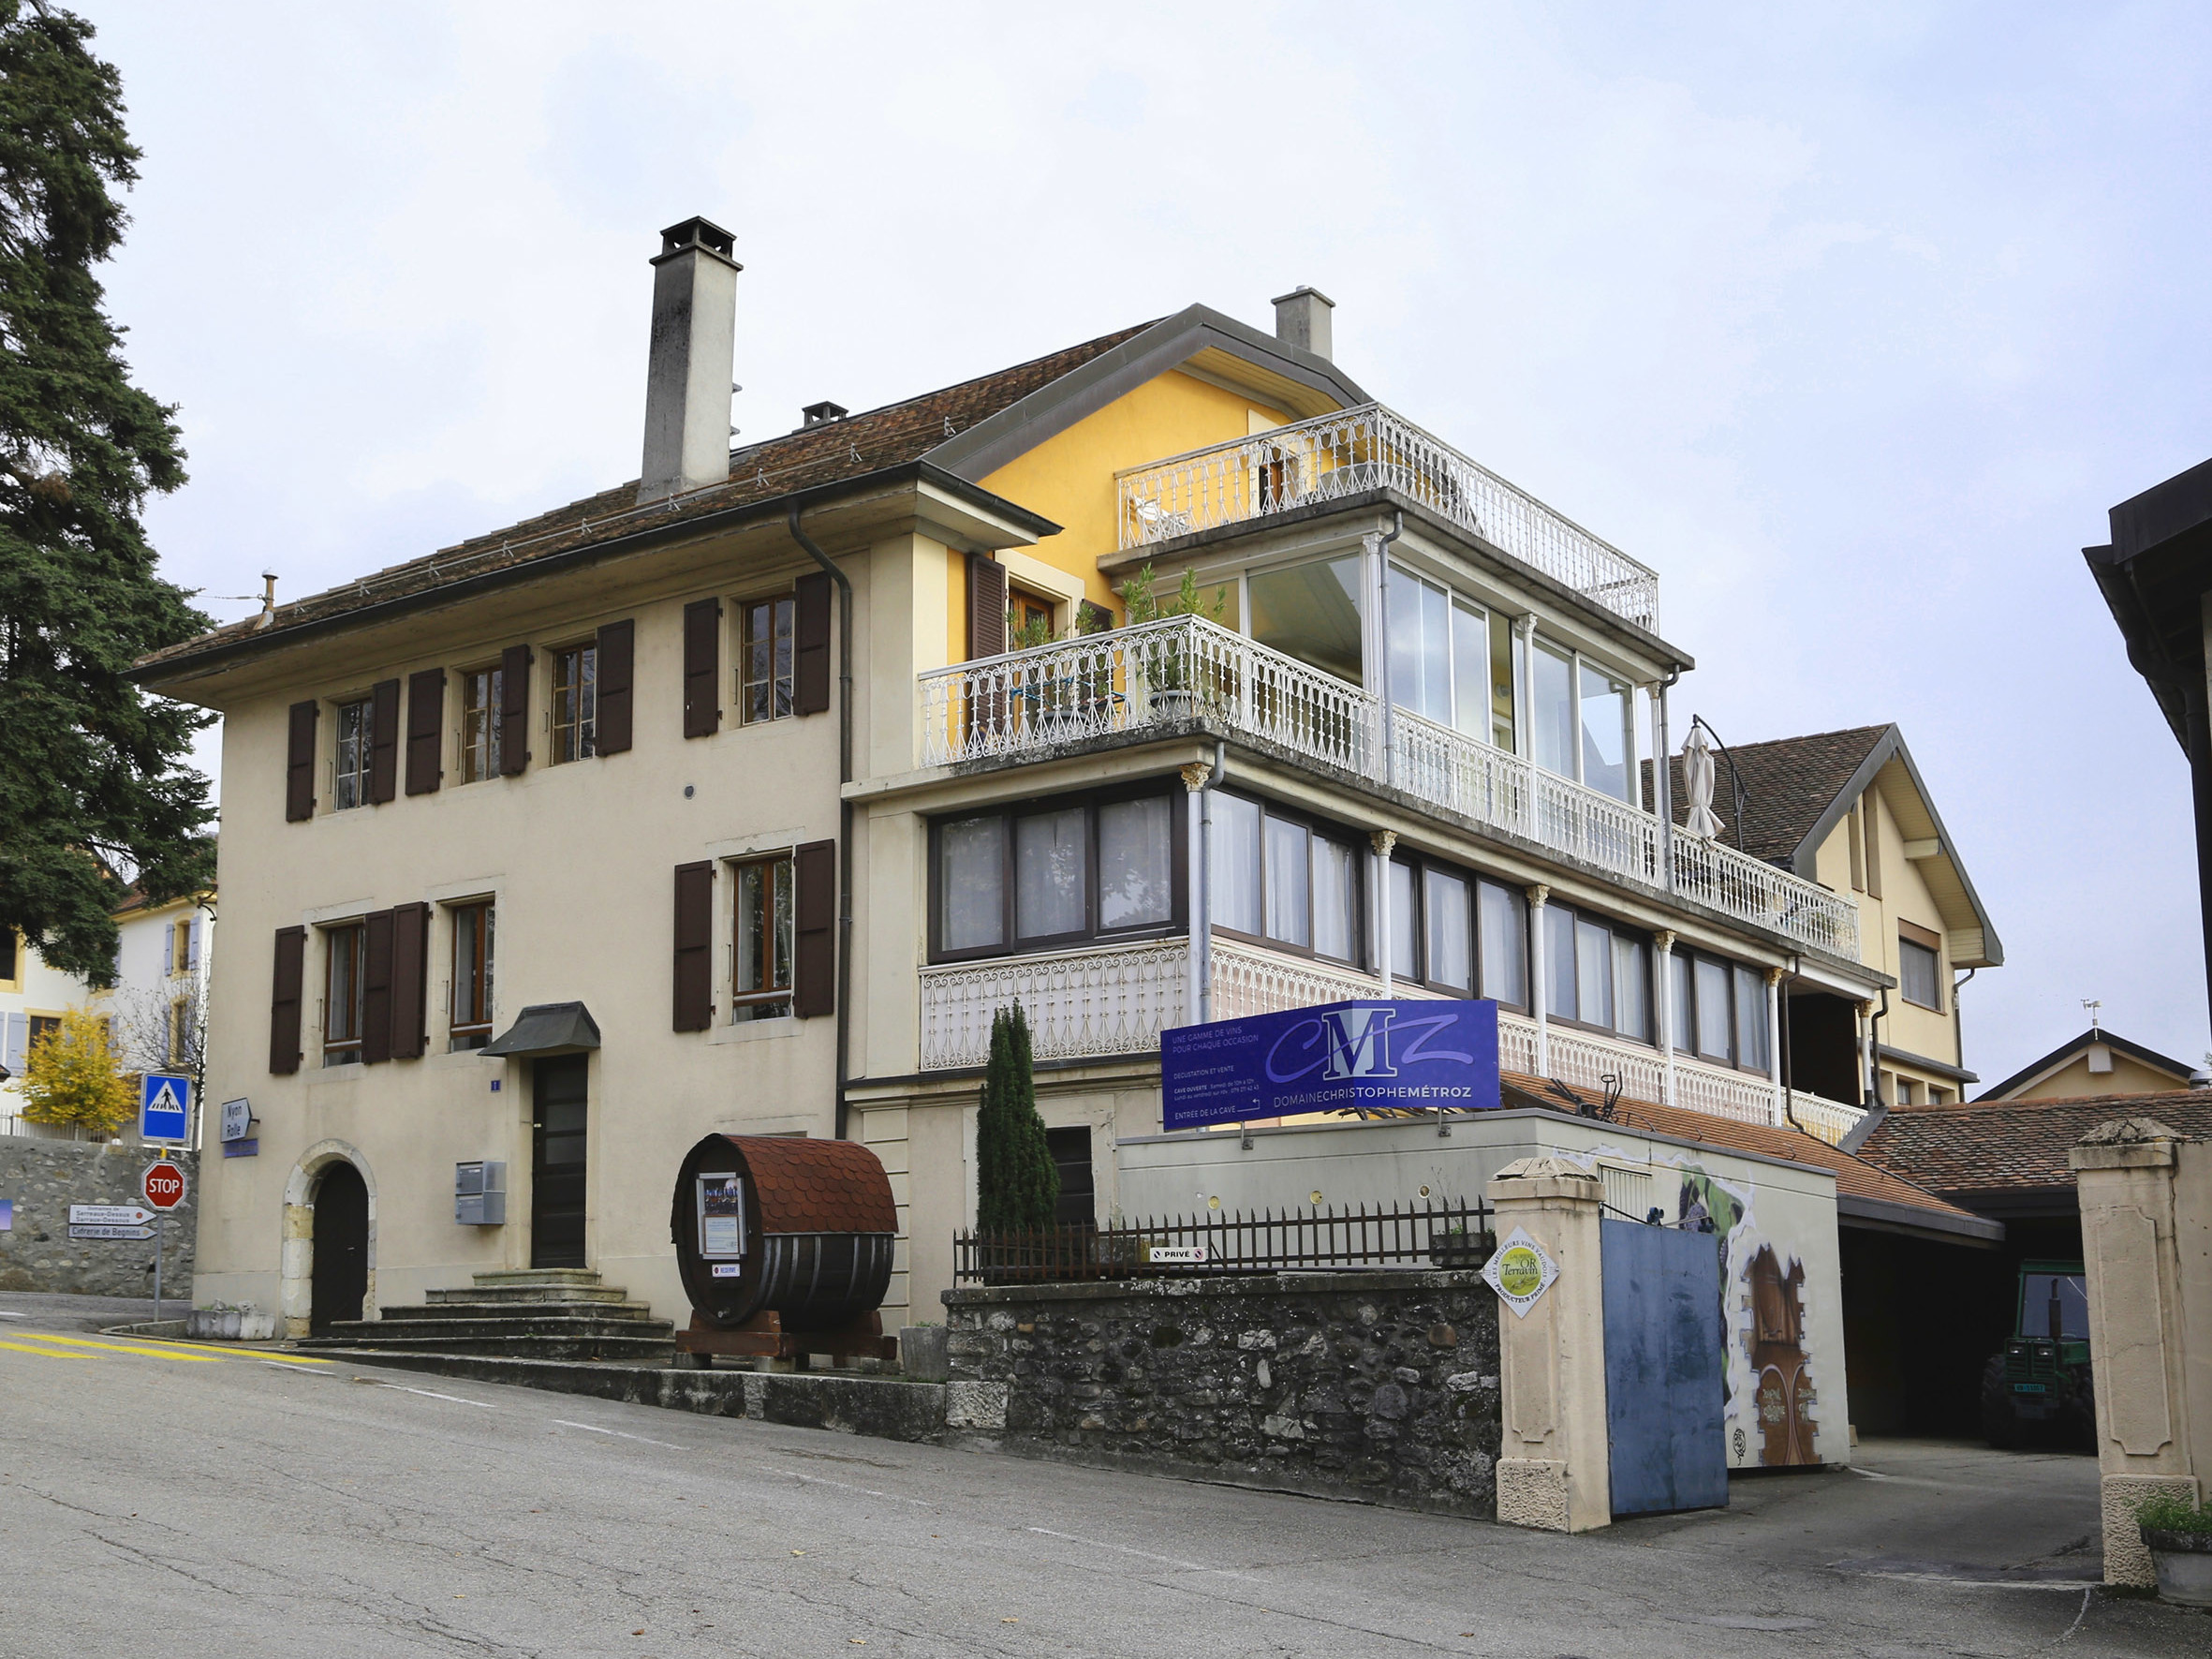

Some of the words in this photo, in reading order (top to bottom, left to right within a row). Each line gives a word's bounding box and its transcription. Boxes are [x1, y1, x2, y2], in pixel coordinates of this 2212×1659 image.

[1172, 1035, 1186, 1044] UNE
[1187, 1030, 1213, 1042] GAMME
[1215, 1029, 1225, 1038] DE
[1226, 1026, 1243, 1035] VINS
[1172, 1044, 1191, 1054] POUR
[1192, 1040, 1221, 1051] CHAQUE
[1222, 1034, 1259, 1046] OCCASION
[1217, 1065, 1234, 1074] VENTE
[1187, 1084, 1207, 1093] OUVERTE
[227, 1104, 242, 1120] Nyon
[1210, 1107, 1218, 1116] LA
[1219, 1105, 1236, 1115] CAVE
[149, 1178, 180, 1193] STOP
[101, 1227, 111, 1236] de
[1164, 1249, 1190, 1258] PRIVÉ
[1493, 1240, 1519, 1266] MEILLEURS
[1521, 1240, 1535, 1251] VINS
[1535, 1248, 1548, 1278] VAUDOIS
[1501, 1263, 1538, 1276] Terravin
[1495, 1283, 1529, 1303] PRODUCTEUR
